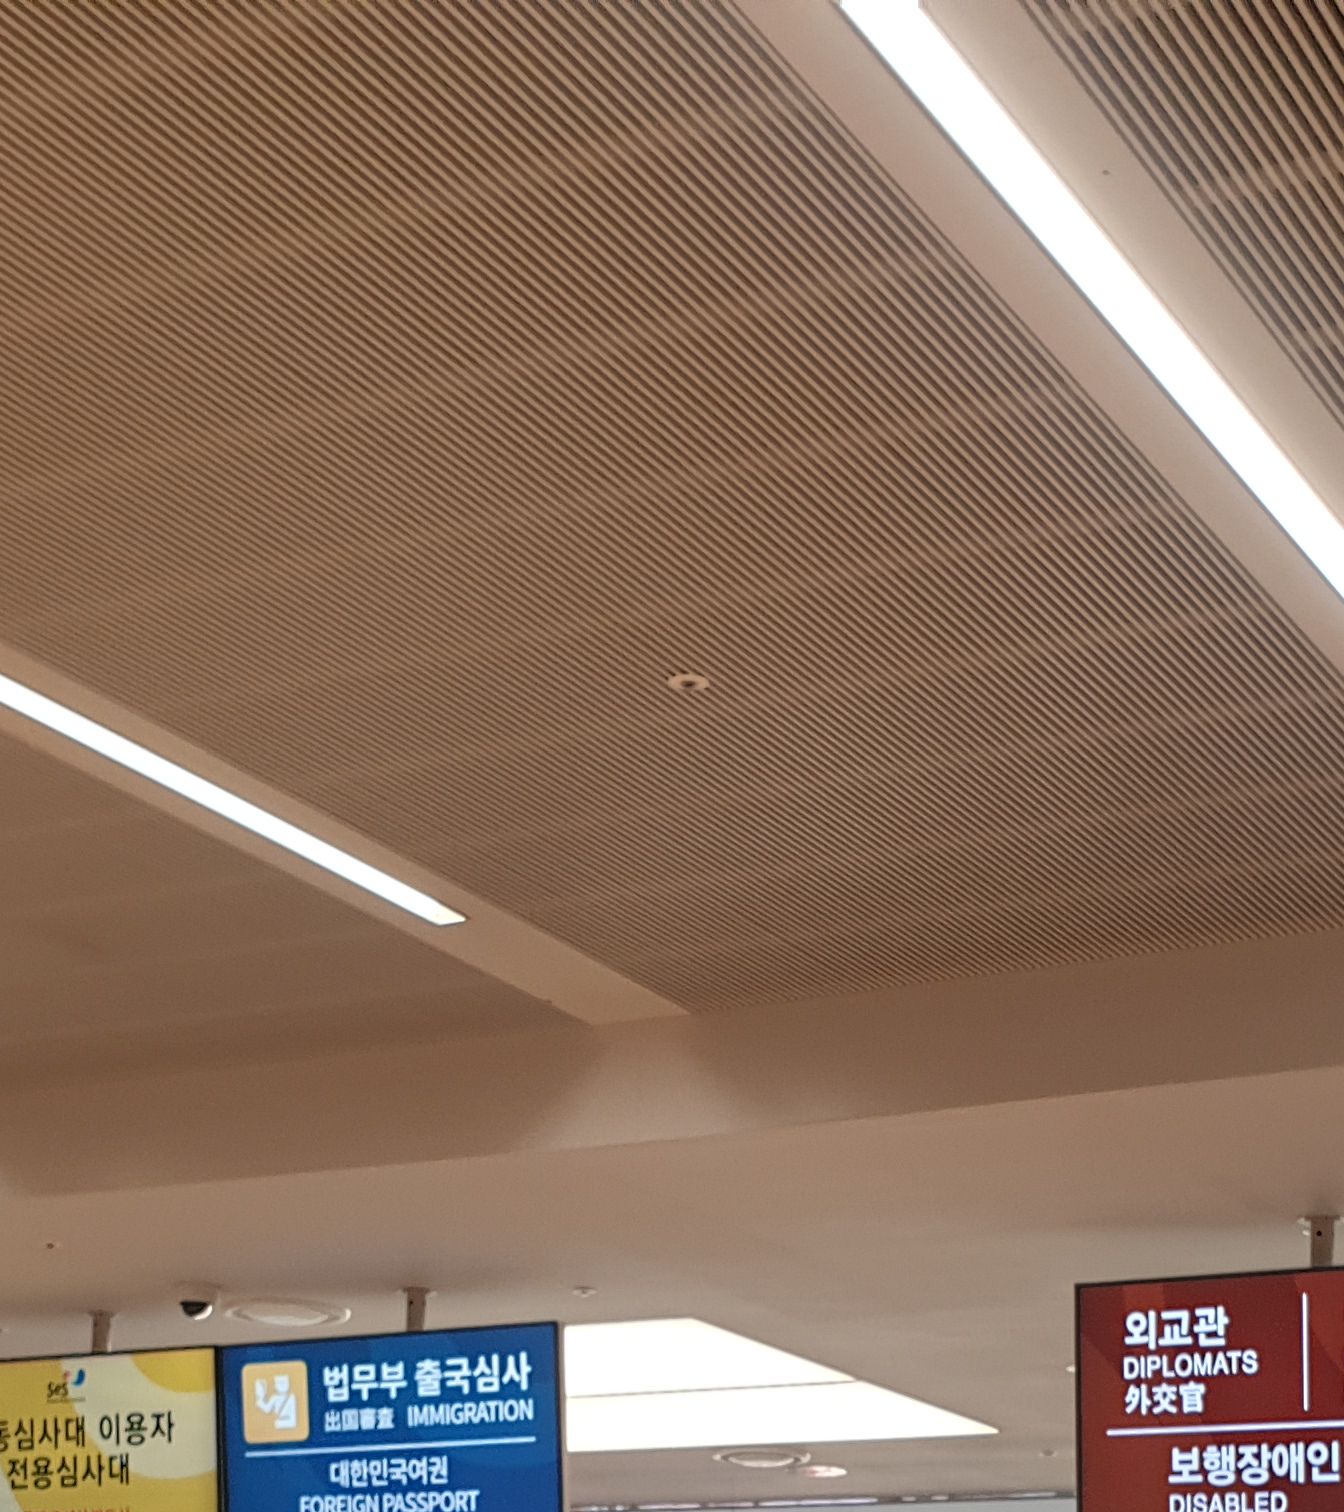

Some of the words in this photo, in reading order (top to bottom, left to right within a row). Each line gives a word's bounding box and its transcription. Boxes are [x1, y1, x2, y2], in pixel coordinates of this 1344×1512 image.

[1124, 1305, 1230, 1350] 외교관
[323, 1361, 408, 1403] 법무부
[415, 1351, 532, 1397] 출국심사
[1123, 1350, 1258, 1380] DIPLOMATS
[408, 1398, 534, 1427] IMMIGRATION
[1124, 1382, 1206, 1416] 外交官
[100, 1410, 175, 1446] 이용자
[8, 1452, 130, 1491] 전용심사대
[329, 1456, 449, 1488] 대한민국여권
[1168, 1441, 1340, 1486] 보행장애인
